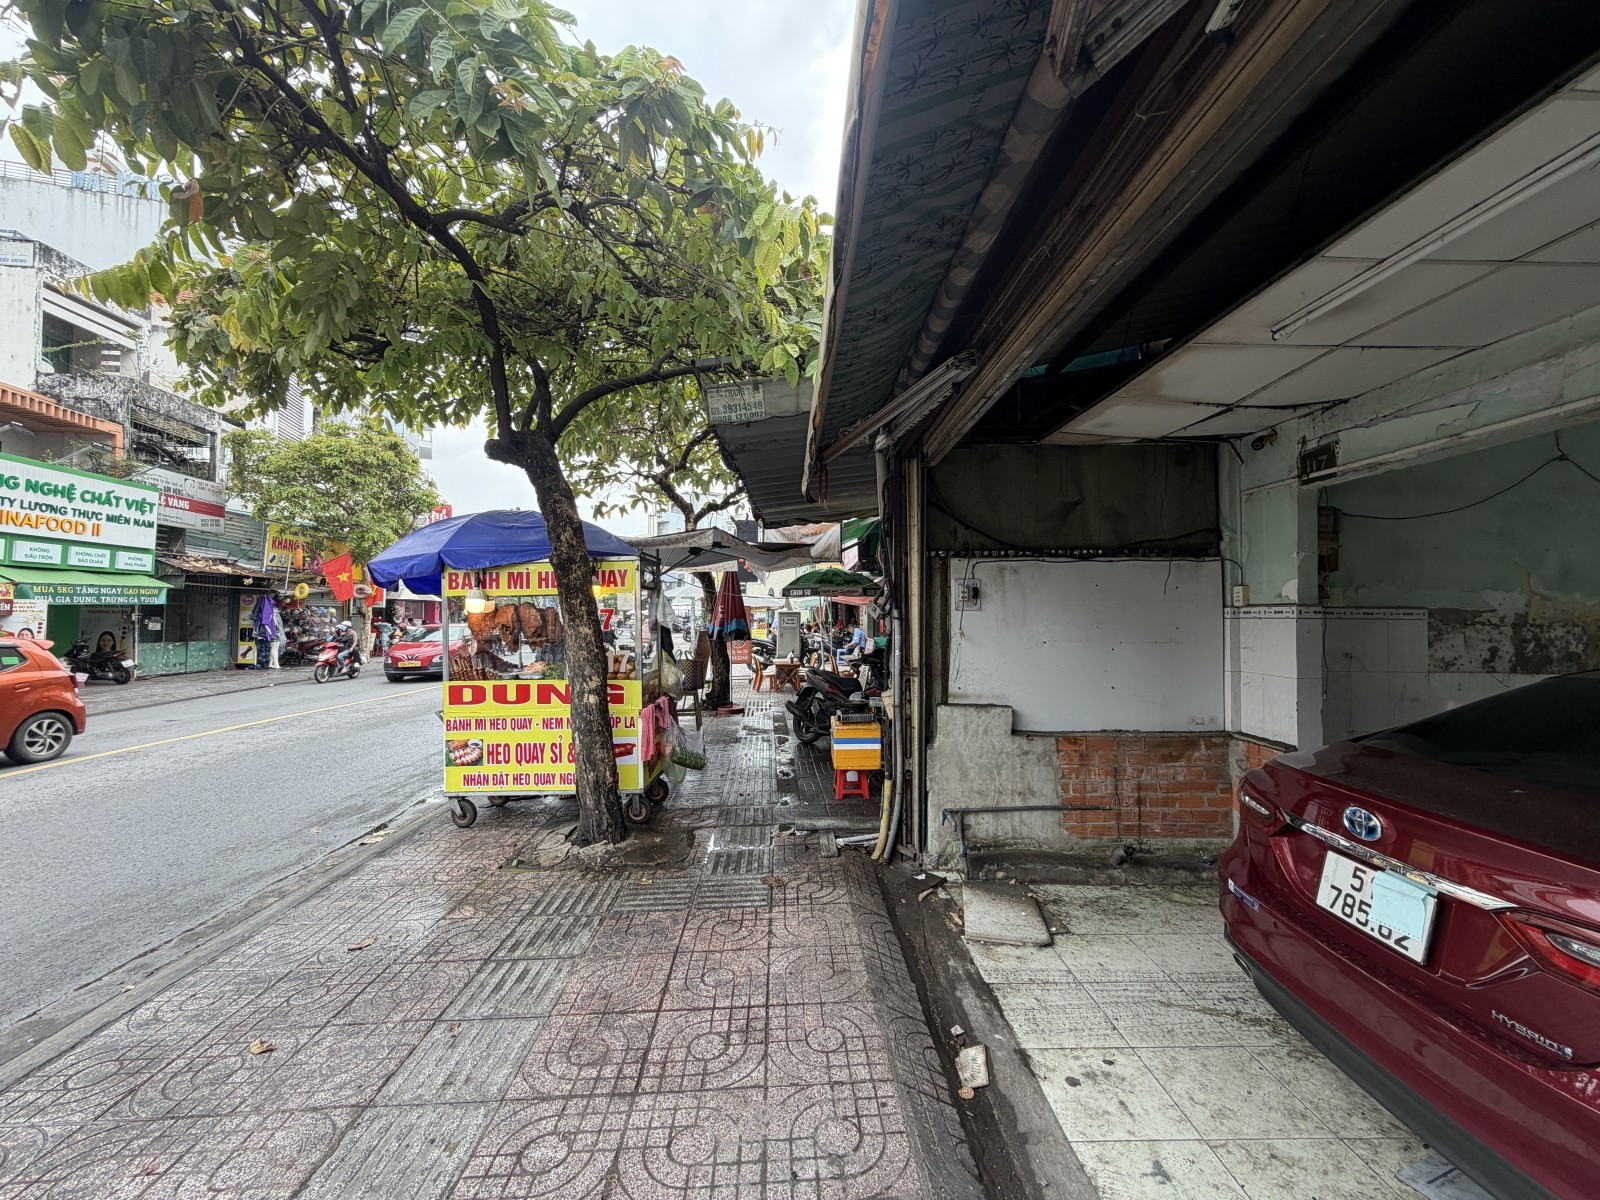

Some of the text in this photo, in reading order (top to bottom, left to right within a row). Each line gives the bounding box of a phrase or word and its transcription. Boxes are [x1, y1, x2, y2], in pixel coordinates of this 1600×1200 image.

[25, 478, 77, 504] NGHỆ
[80, 489, 123, 509] CHẤT
[124, 497, 157, 516] VIỆT
[167, 496, 190, 510] VÀNG
[0, 496, 17, 508] TY
[20, 498, 69, 516] LƯƠNG
[70, 507, 104, 522] THỰC
[133, 518, 155, 529] NAM
[91, 522, 102, 537] II
[29, 546, 50, 554] KHÔNG
[271, 536, 300, 550] KHANG
[507, 568, 531, 589] MÌ
[537, 570, 558, 589] HE
[57, 586, 74, 594] 5KG
[76, 586, 99, 595] TẶNG
[100, 587, 122, 595] NGAY
[123, 588, 139, 596] GẠO
[446, 716, 472, 731] BÁNH
[475, 716, 486, 731] MÌ
[489, 718, 507, 731] HEO
[510, 718, 533, 732] QUAY
[542, 717, 563, 730] NEM
[624, 716, 636, 729] LA
[486, 742, 511, 765] HEO
[515, 742, 546, 767] QUAY
[550, 735, 563, 764] SỈ
[463, 771, 489, 789] NHẬN
[492, 771, 509, 789] ĐẶT
[512, 773, 531, 786] HEO
[534, 773, 556, 788] QUAY
